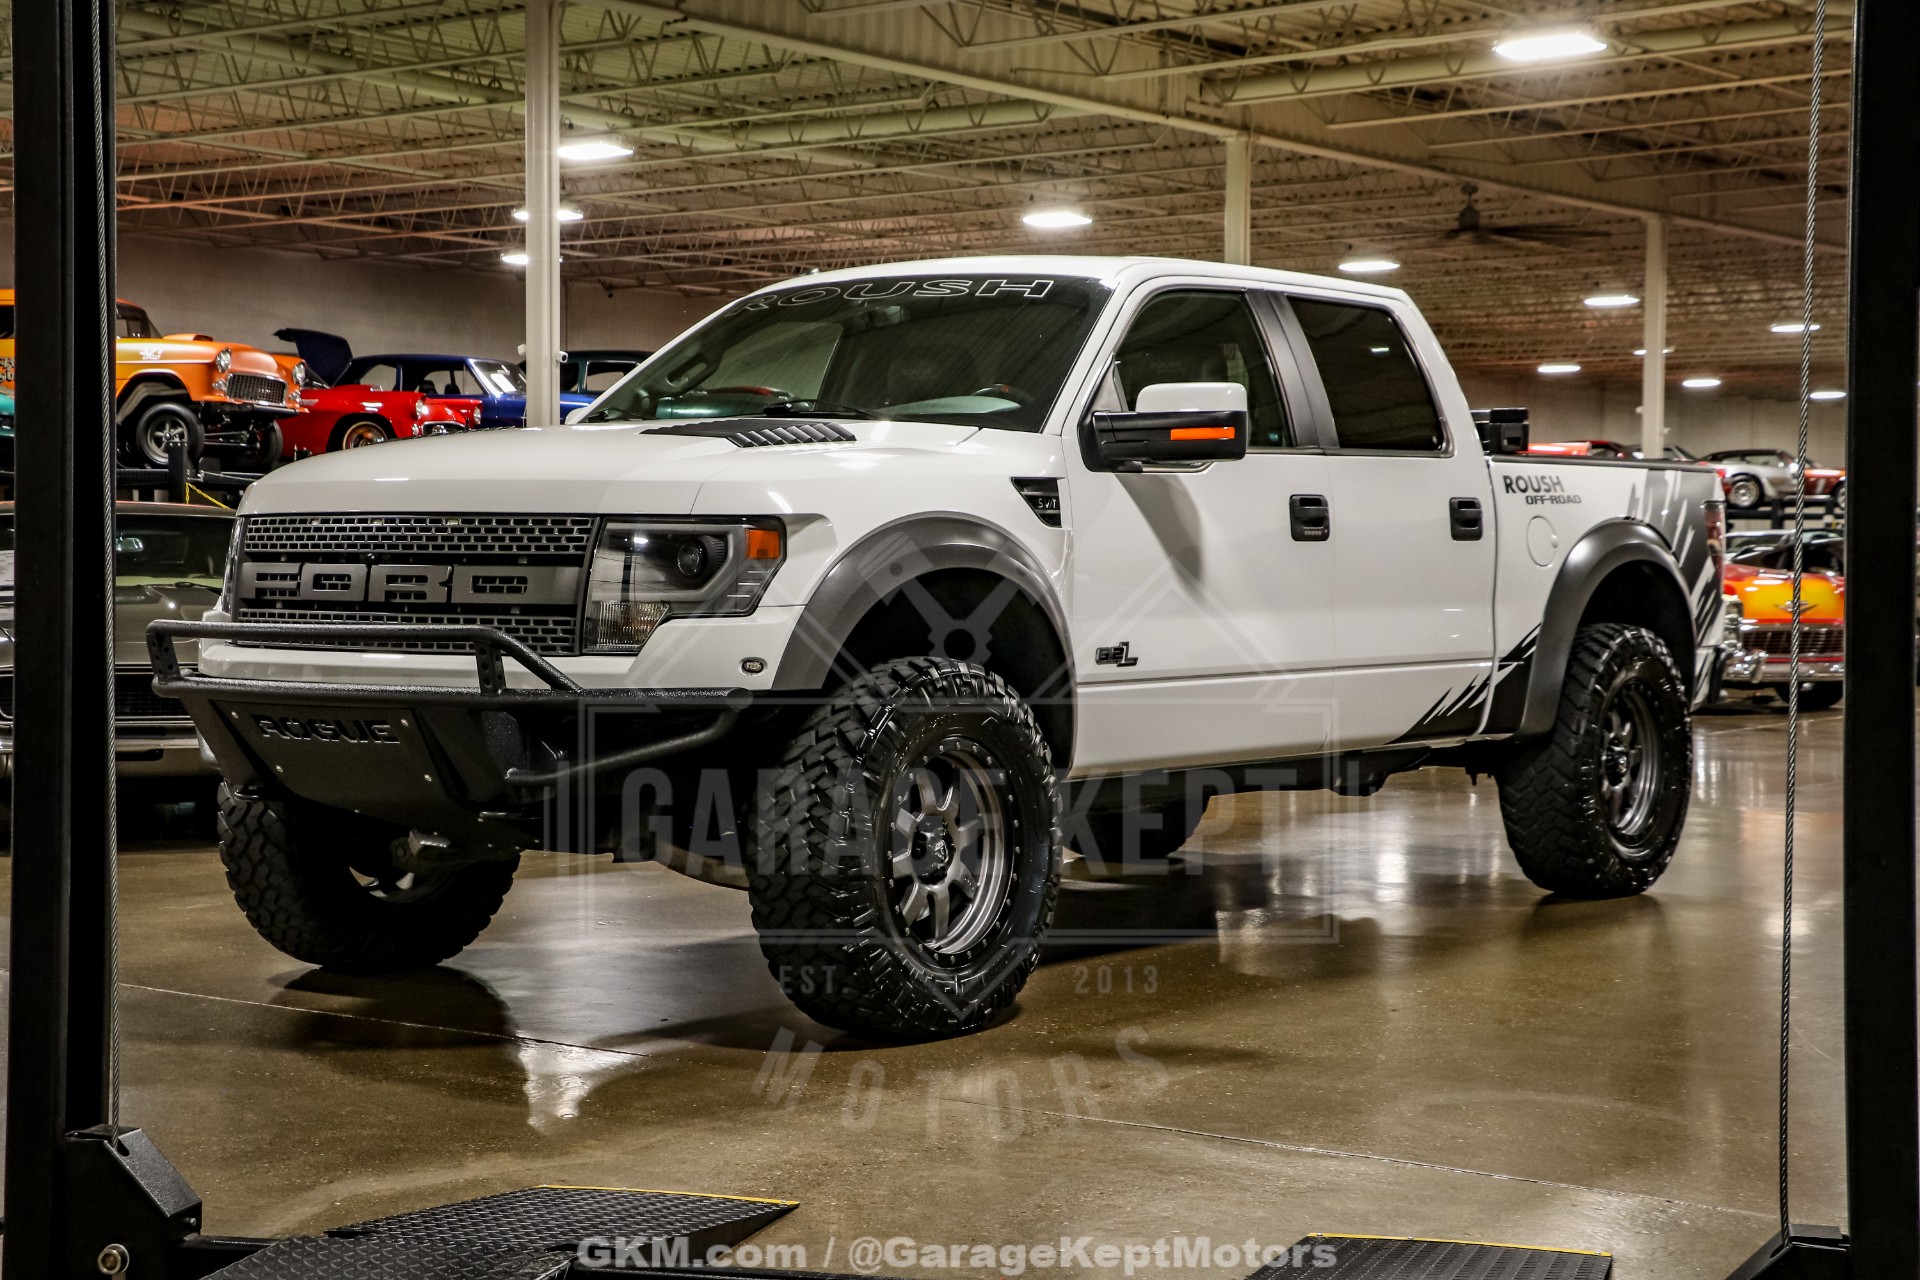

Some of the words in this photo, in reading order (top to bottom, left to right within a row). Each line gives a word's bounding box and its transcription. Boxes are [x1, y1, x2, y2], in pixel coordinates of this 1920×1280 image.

[725, 279, 1055, 317] ROUSH
[1503, 475, 1565, 493] ROUSH
[1525, 495, 1582, 505] OFF-ROAD
[239, 562, 560, 604] FORD
[251, 714, 400, 744] ROGUE
